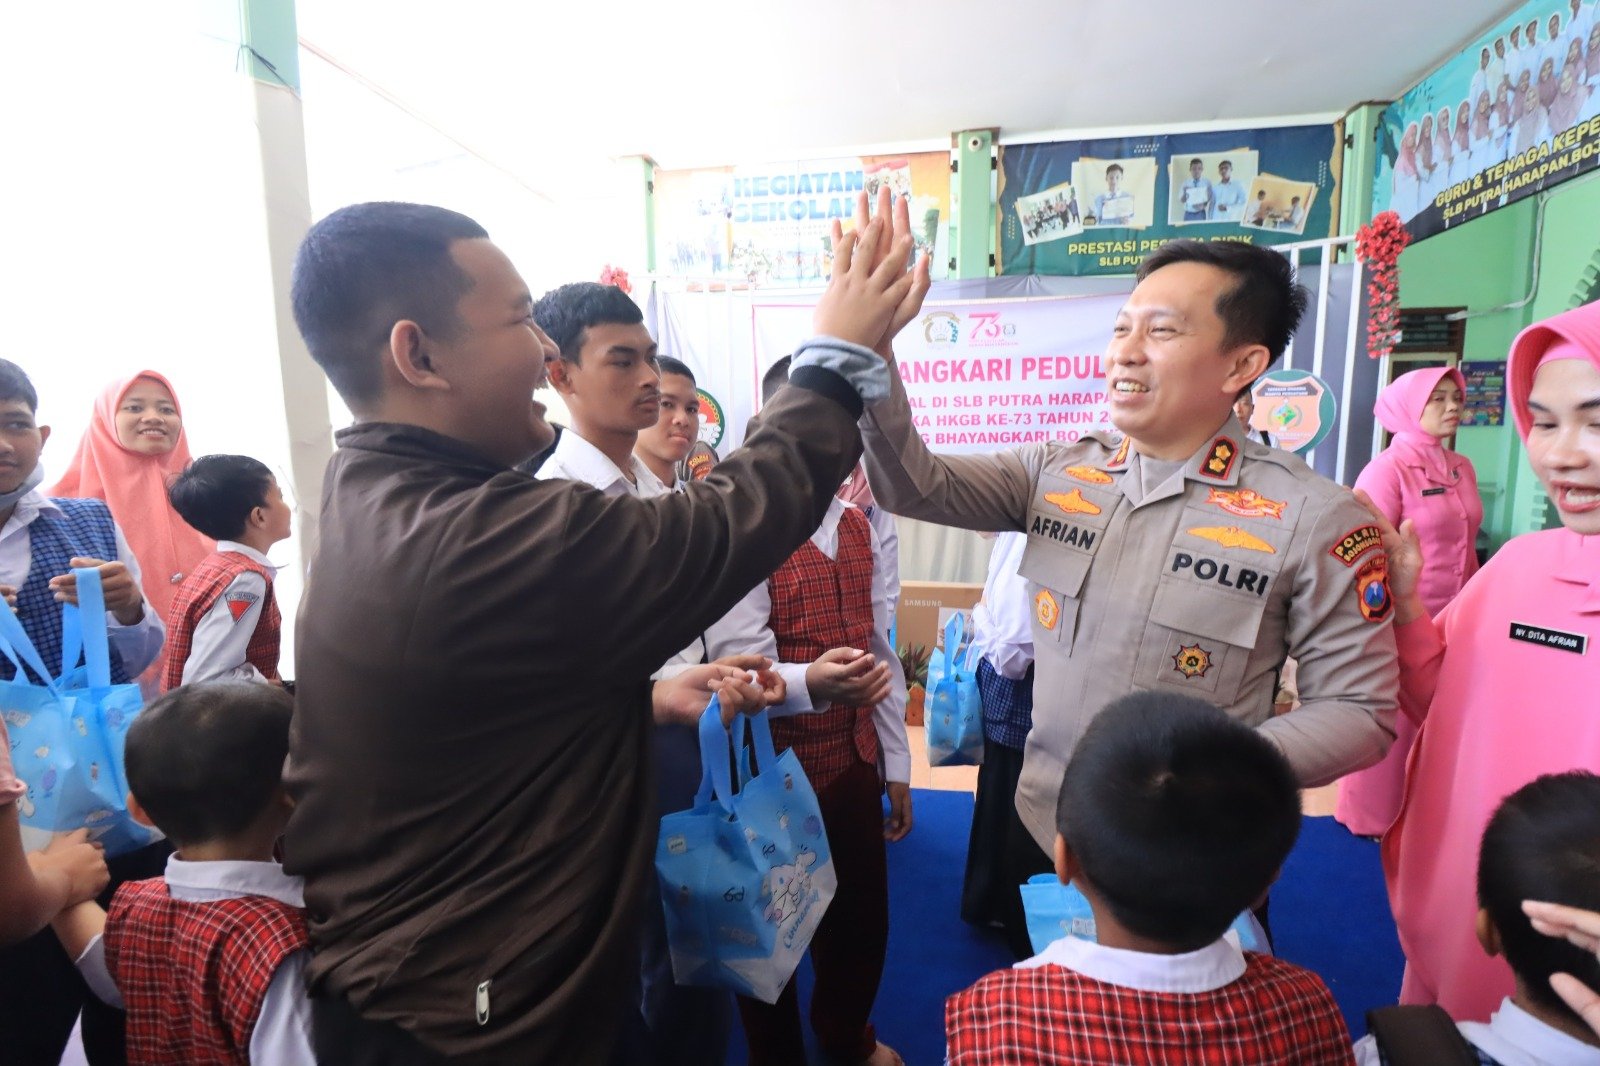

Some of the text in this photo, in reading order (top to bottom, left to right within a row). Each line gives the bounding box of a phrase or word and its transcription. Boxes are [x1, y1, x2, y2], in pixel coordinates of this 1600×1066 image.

[734, 170, 863, 197] KEGIATAN
[1436, 180, 1471, 208] GURU
[1473, 174, 1483, 189] &
[1486, 141, 1549, 183] TENAGA
[1443, 203, 1463, 220] SLB
[1464, 189, 1501, 211] PUTRA
[1068, 240, 1136, 255] PRESTASI
[1099, 257, 1120, 266] SLB
[968, 312, 1002, 339] 73
[900, 358, 1011, 384] ANGKARI
[932, 396, 947, 408] DI
[953, 394, 982, 408] SLB
[988, 393, 1043, 407] PUTRA
[936, 414, 981, 426] HKGB
[987, 413, 1031, 425] KE-73
[1038, 411, 1093, 424] TAHUN
[936, 430, 1050, 444] BHAYANGKARI
[1030, 514, 1096, 551] AFRIAN
[1171, 552, 1270, 596] POLRI
[904, 599, 942, 607] SAMSUNG
[1528, 630, 1546, 641] DITA
[1547, 634, 1578, 648] AFRIAN
